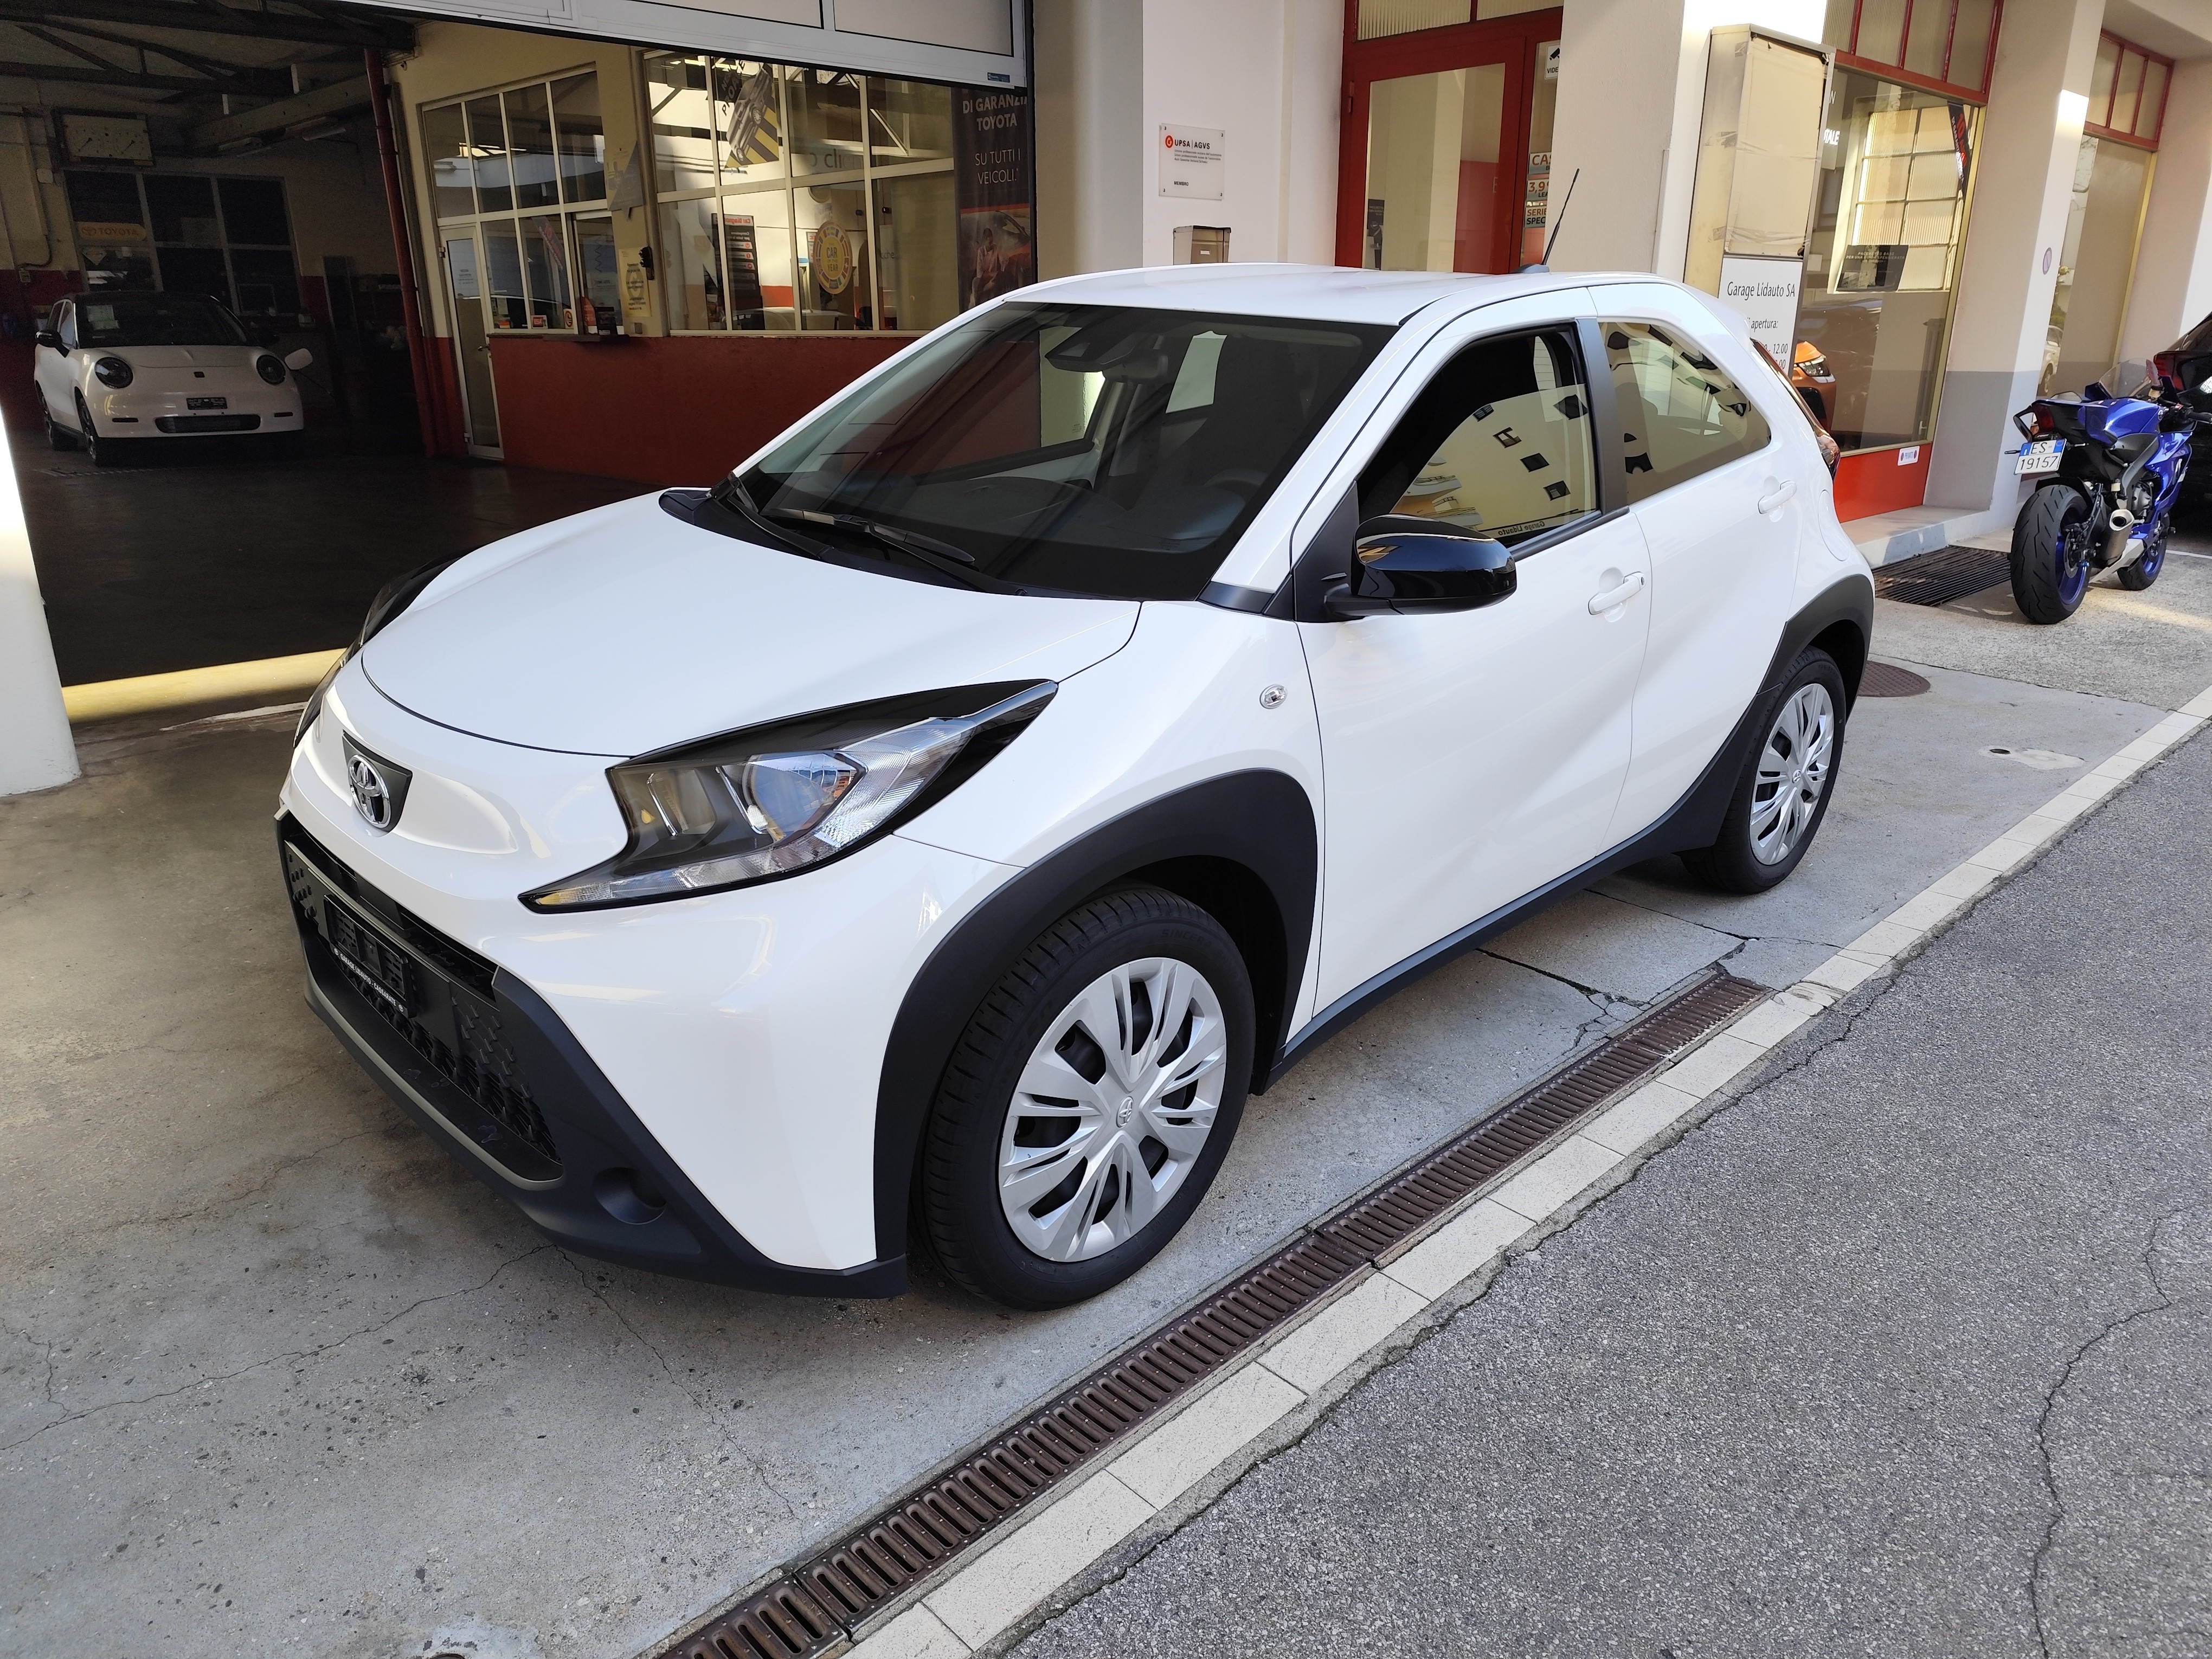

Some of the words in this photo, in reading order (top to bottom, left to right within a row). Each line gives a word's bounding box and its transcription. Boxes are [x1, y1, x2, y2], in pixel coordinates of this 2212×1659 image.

[962, 99, 973, 114] DI
[976, 113, 1018, 131] TOYOTA
[1174, 139, 1191, 147] UPSA
[1194, 142, 1211, 150] AGVS
[975, 152, 987, 166] SU
[990, 149, 1015, 164] TUTTI
[1018, 147, 1020, 161] I
[1528, 181, 1549, 194] 3,9
[98, 227, 139, 236] TOYOTA
[826, 247, 838, 259] CAR
[827, 263, 839, 272] YEAR
[1727, 281, 1755, 300] Garage
[1757, 282, 1784, 298] Lidauto
[1786, 283, 1796, 297] SA
[1751, 319, 1778, 332] apertura:
[1772, 343, 1788, 354] 12.00
[2030, 442, 2048, 454] ES
[2020, 455, 2059, 471] 19157
[1161, 929, 1212, 949] SINCERA
[340, 953, 355, 971] GARAGE
[355, 966, 371, 985] LIDAUTO
[374, 982, 396, 1006] CASSARATE
